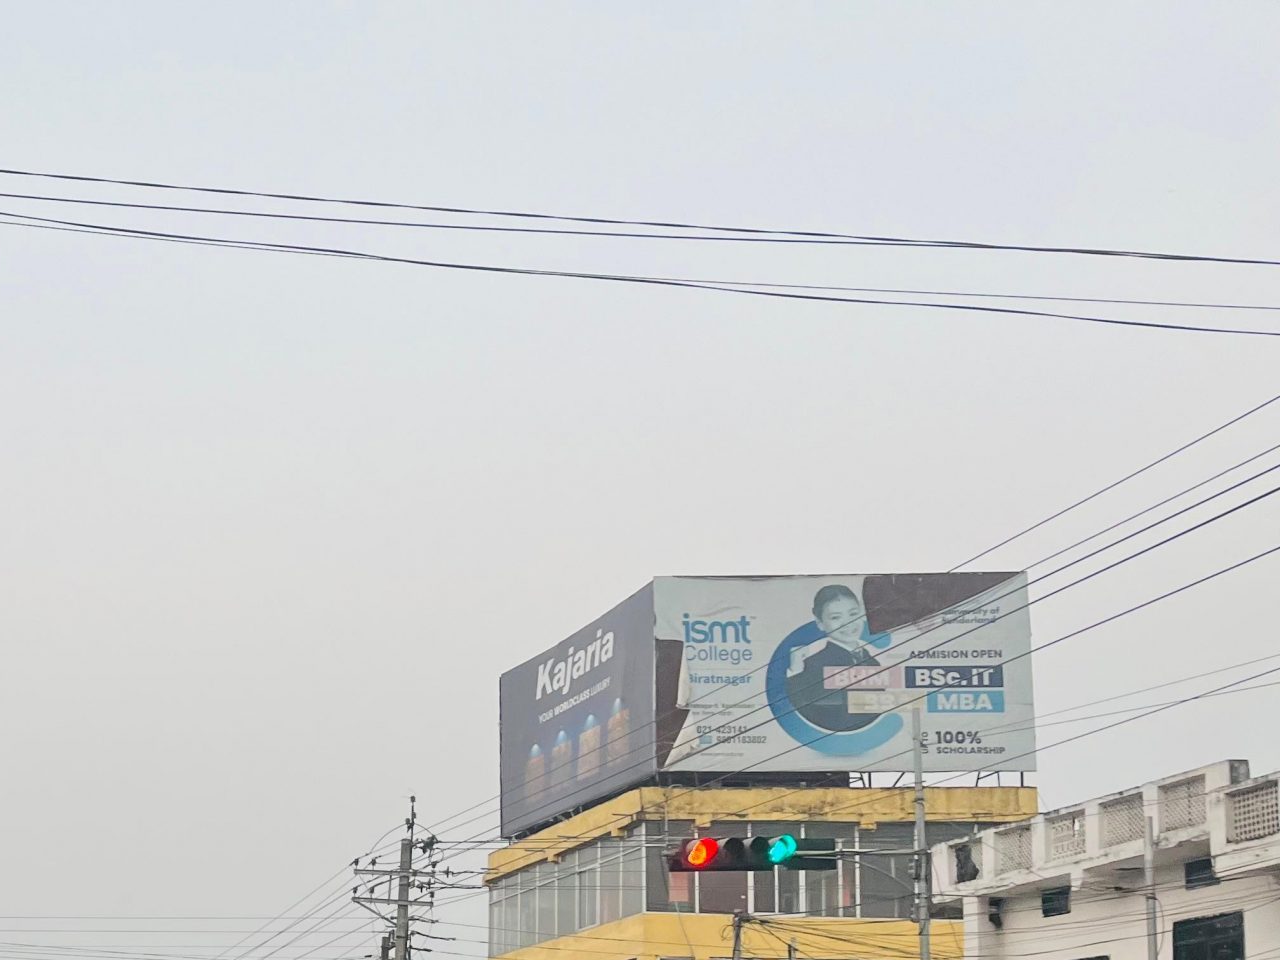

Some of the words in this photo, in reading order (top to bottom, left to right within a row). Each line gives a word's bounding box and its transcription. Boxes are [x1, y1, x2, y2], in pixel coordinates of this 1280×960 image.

[682, 613, 751, 644] ismt
[685, 645, 753, 665] College
[971, 649, 1002, 658] OPEN
[535, 628, 614, 701] Kajaria
[688, 673, 752, 686] Biratnagar
[936, 693, 993, 710] MBA
[935, 731, 982, 744] 100%
[936, 746, 1006, 755] SCHOLARSHIP
